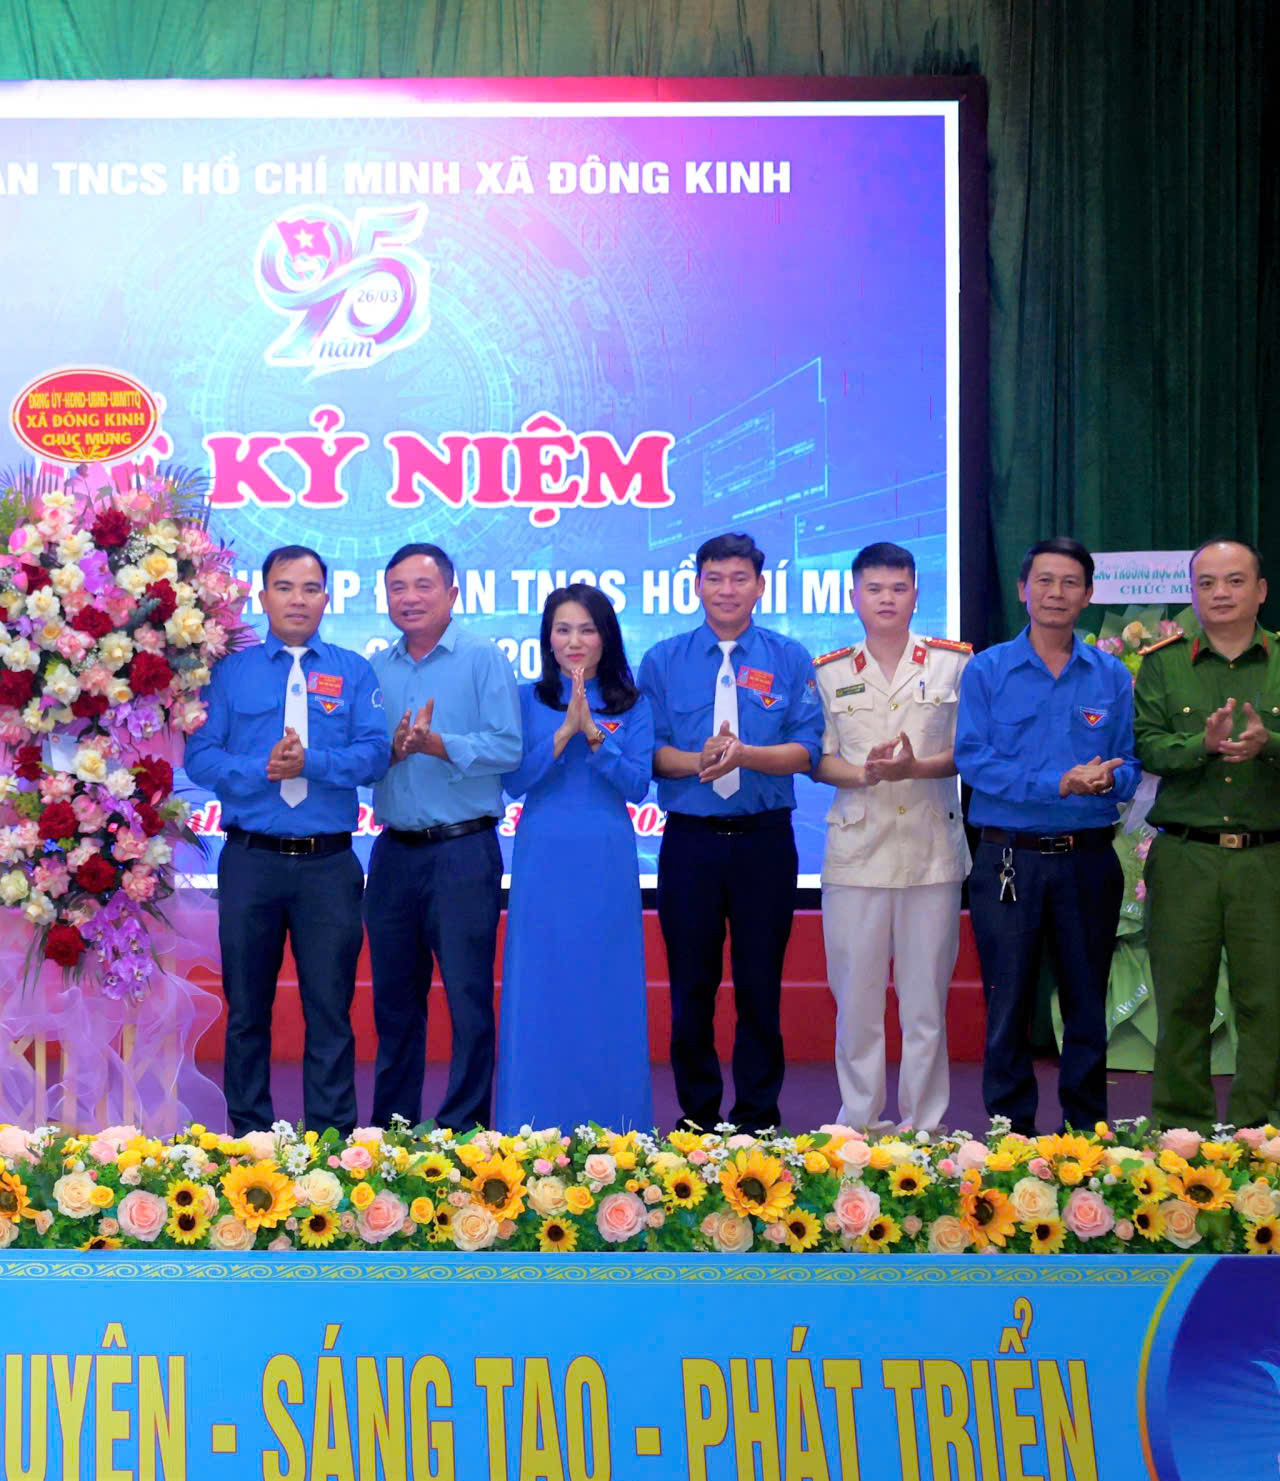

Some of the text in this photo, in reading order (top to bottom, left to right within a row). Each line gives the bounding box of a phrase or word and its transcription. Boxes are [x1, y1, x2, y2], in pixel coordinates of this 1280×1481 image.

[52, 161, 168, 195] TNCS
[182, 151, 240, 195] HỒ
[254, 155, 328, 195] CHÍ
[344, 161, 461, 195] MINH
[475, 155, 535, 195] XÃ
[548, 154, 670, 195] ĐÔNG
[685, 161, 791, 195] KINH
[357, 289, 398, 304] 26/03
[319, 338, 374, 358] năm
[26, 410, 145, 428] XÃ ĐÔNG KINH
[41, 431, 132, 447] CHÚC MỪNG
[206, 410, 674, 524] KỶ NIỆM
[1120, 582, 1165, 595] CHÚC
[261, 1322, 455, 1481] SÁNG
[681, 1326, 866, 1481] PHÁT
[881, 1297, 1097, 1481] TRIỂN
